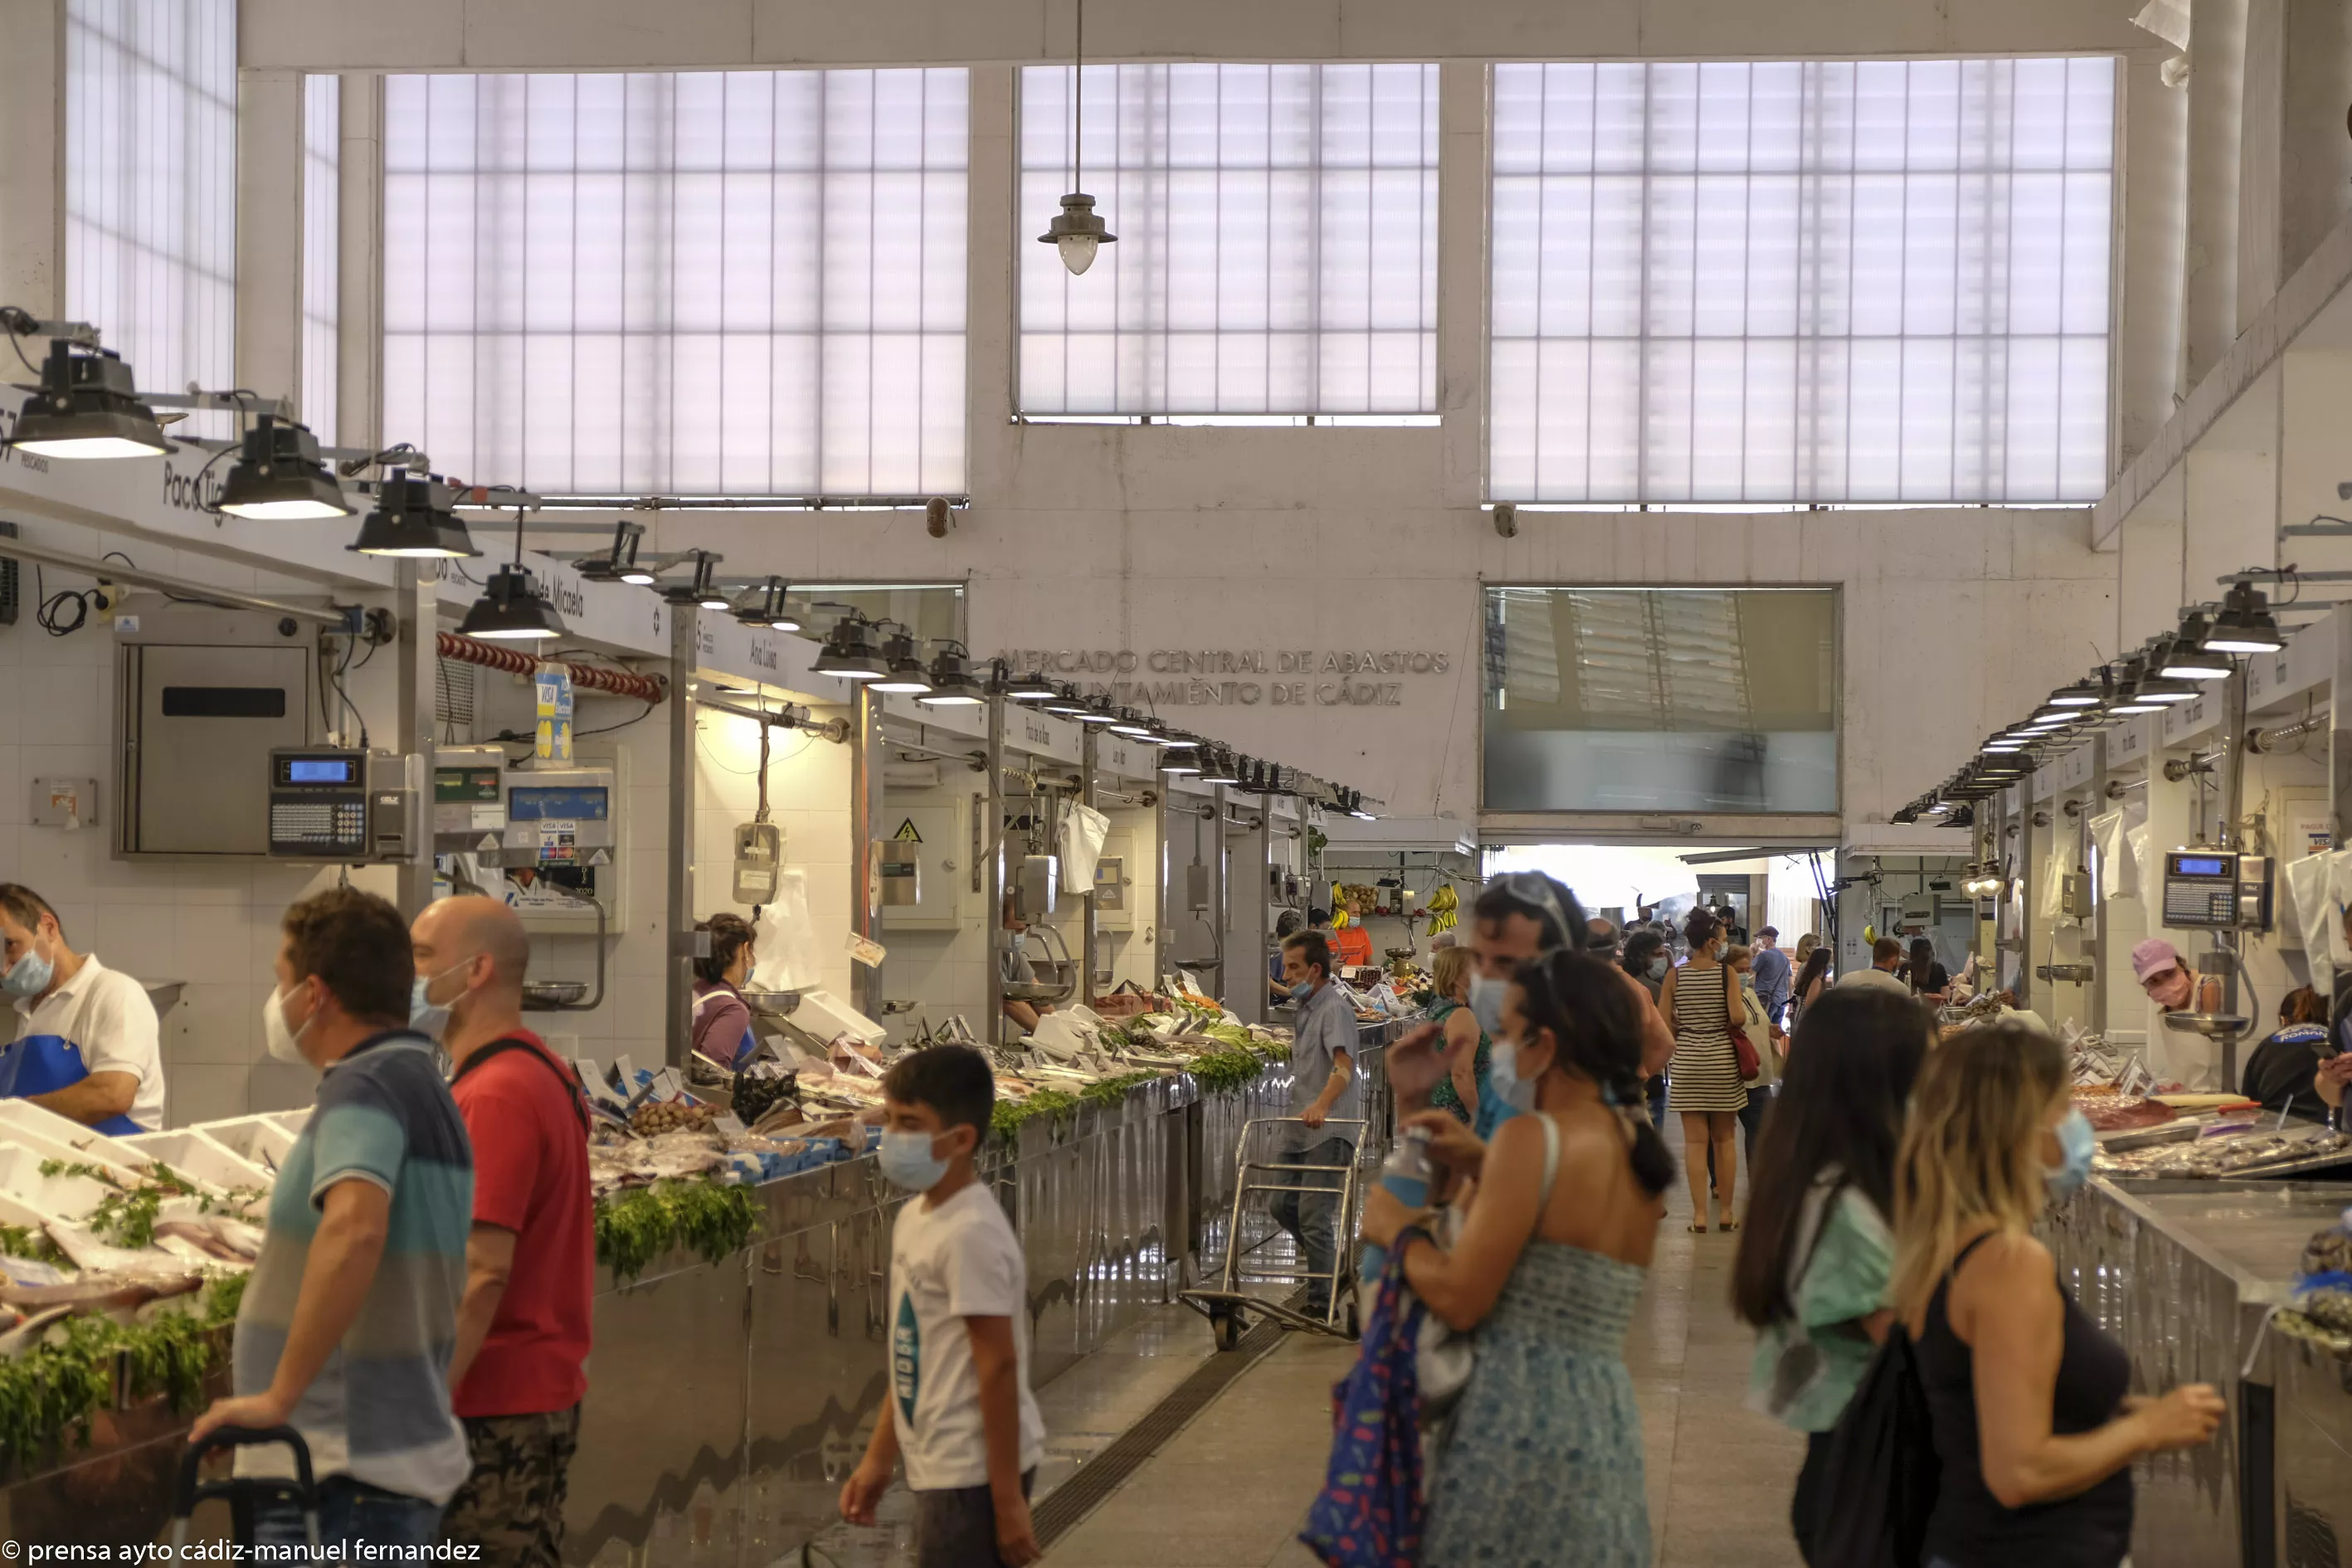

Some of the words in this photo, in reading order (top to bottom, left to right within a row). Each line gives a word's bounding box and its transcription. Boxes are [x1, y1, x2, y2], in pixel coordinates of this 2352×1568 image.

[163, 460, 201, 511] Paco
[552, 575, 583, 617] Micaela
[749, 633, 762, 666] Ana
[998, 649, 1138, 674] MERCADO
[1148, 650, 1268, 674] CENTRAL
[1277, 650, 1312, 674] DE
[1320, 650, 1449, 674] ABASTOS
[542, 686, 553, 704] VISA
[1272, 683, 1306, 706] DE
[1315, 675, 1402, 706] CÁDIZ
